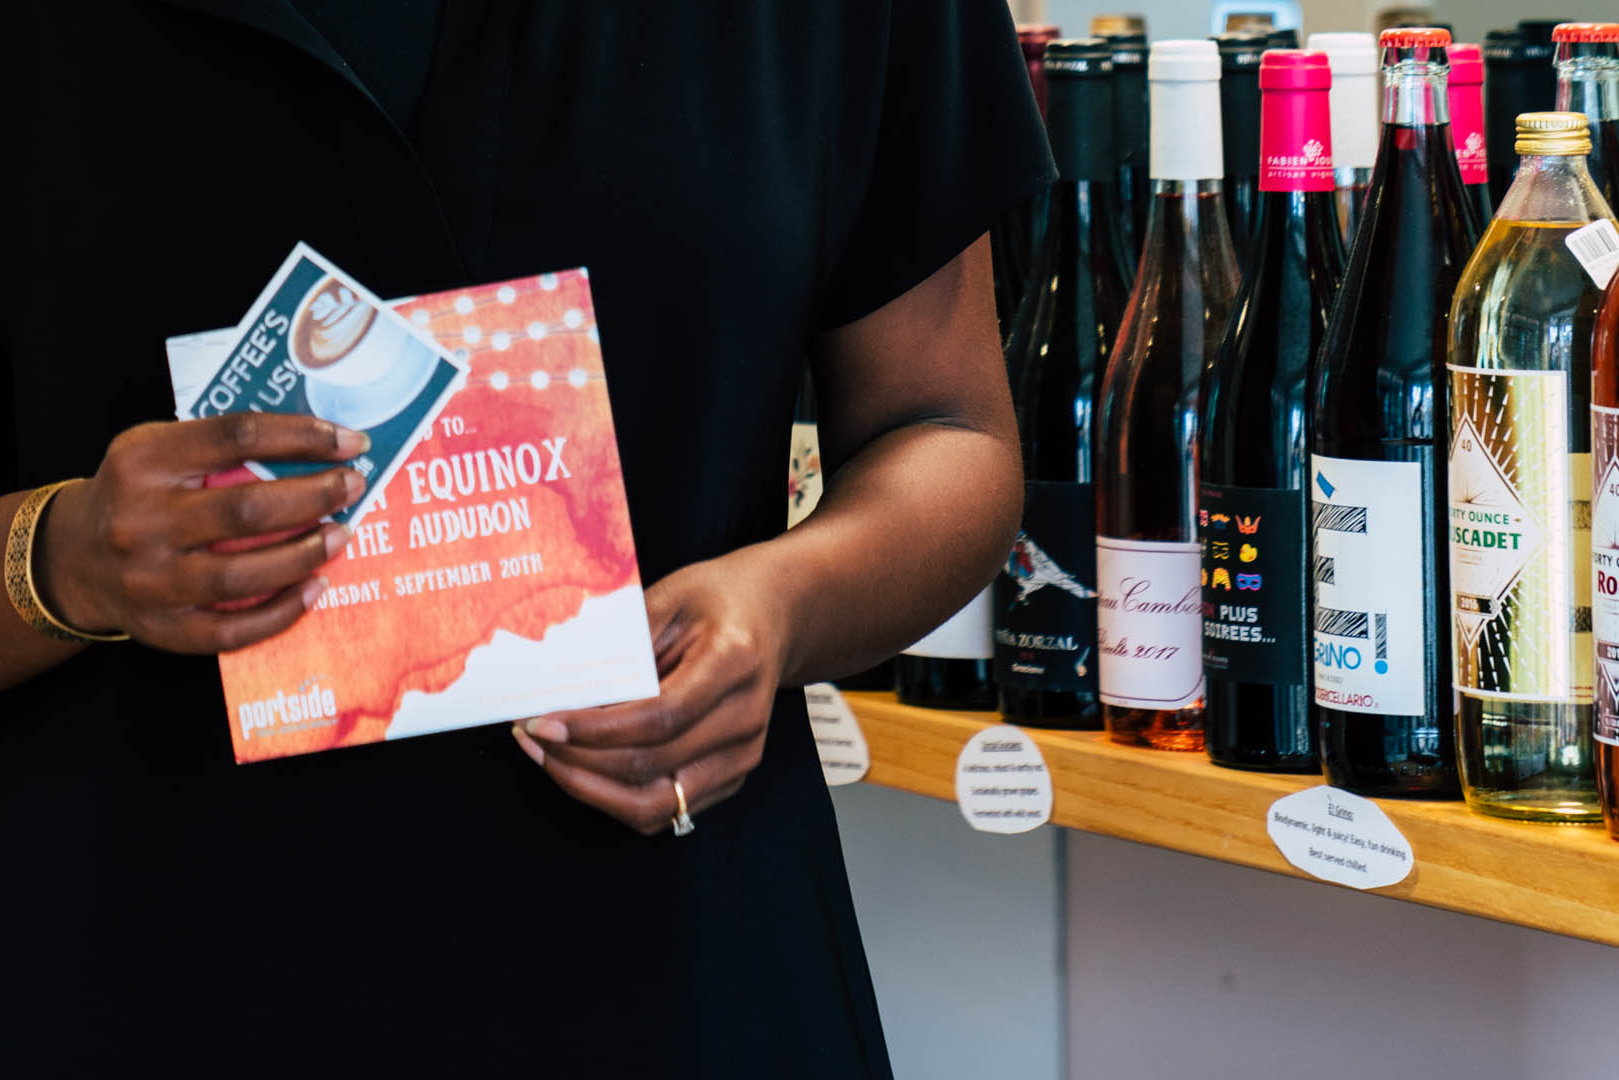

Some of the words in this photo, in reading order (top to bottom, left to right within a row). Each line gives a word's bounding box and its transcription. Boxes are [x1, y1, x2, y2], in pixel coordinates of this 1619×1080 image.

[1267, 156, 1308, 167] FABIEN
[198, 309, 289, 419] COFFEE'S
[1460, 439, 1473, 453] 40
[405, 436, 572, 505] EQUINOX
[409, 497, 532, 550] AUDUBON
[1468, 510, 1510, 525] OUNCE
[1450, 526, 1522, 550] SCADET
[393, 561, 492, 597] SEPTEMBER
[499, 553, 544, 580] 20TH
[1219, 605, 1259, 623] PLUS
[1017, 632, 1080, 651] ZORZAL
[1133, 644, 1181, 660] 2017
[238, 684, 337, 741] portside
